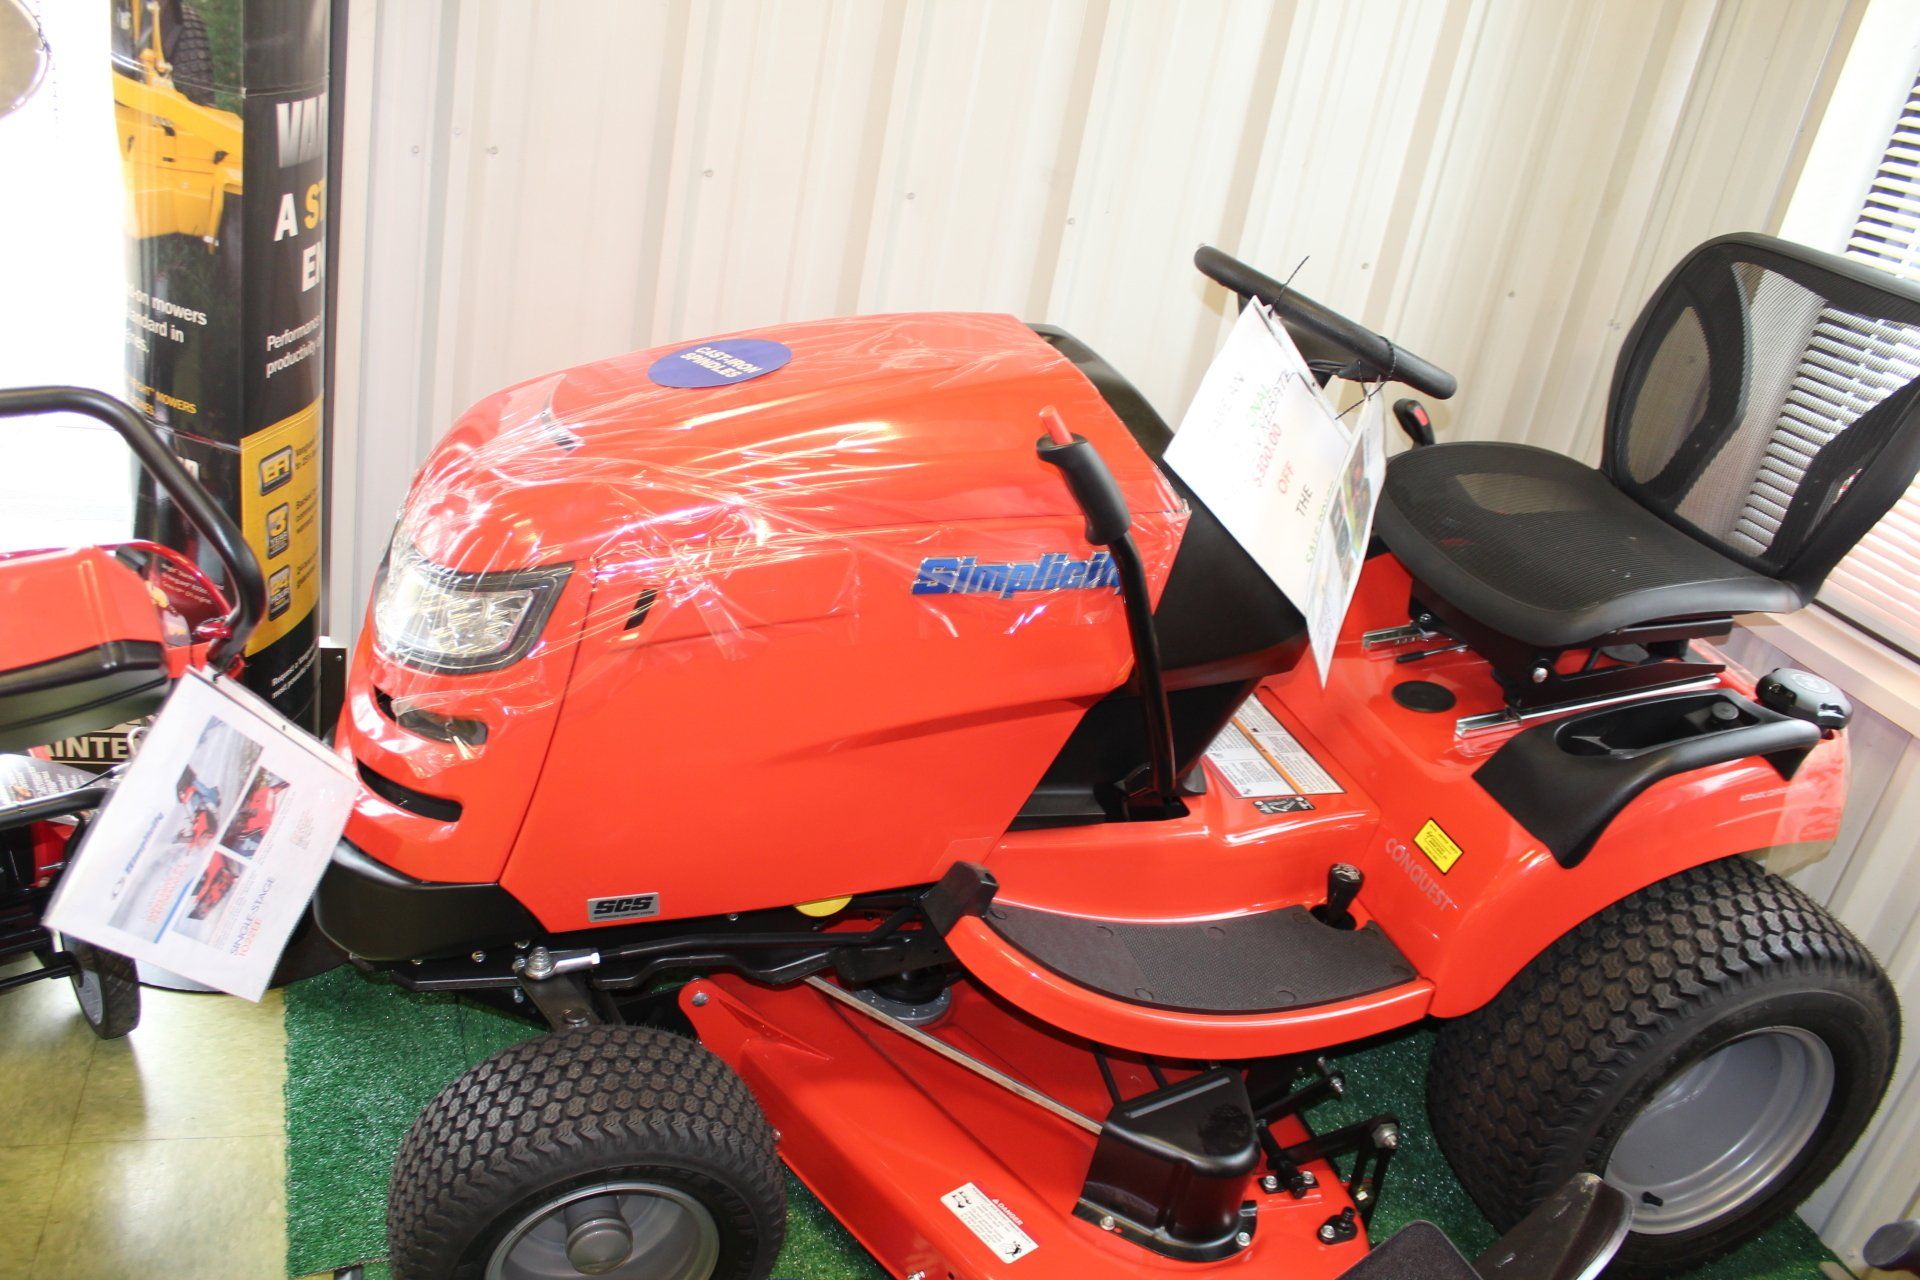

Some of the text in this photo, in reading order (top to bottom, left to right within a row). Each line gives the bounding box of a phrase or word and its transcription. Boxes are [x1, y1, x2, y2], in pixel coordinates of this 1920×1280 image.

[273, 193, 298, 242] A
[151, 296, 208, 326] mowers
[170, 324, 185, 343] in
[680, 352, 742, 378] SPINDLES
[694, 346, 764, 373] CAST-IRON
[1295, 483, 1313, 517] THE
[1385, 838, 1451, 911] CONQUEST
[594, 896, 654, 914] SCS
